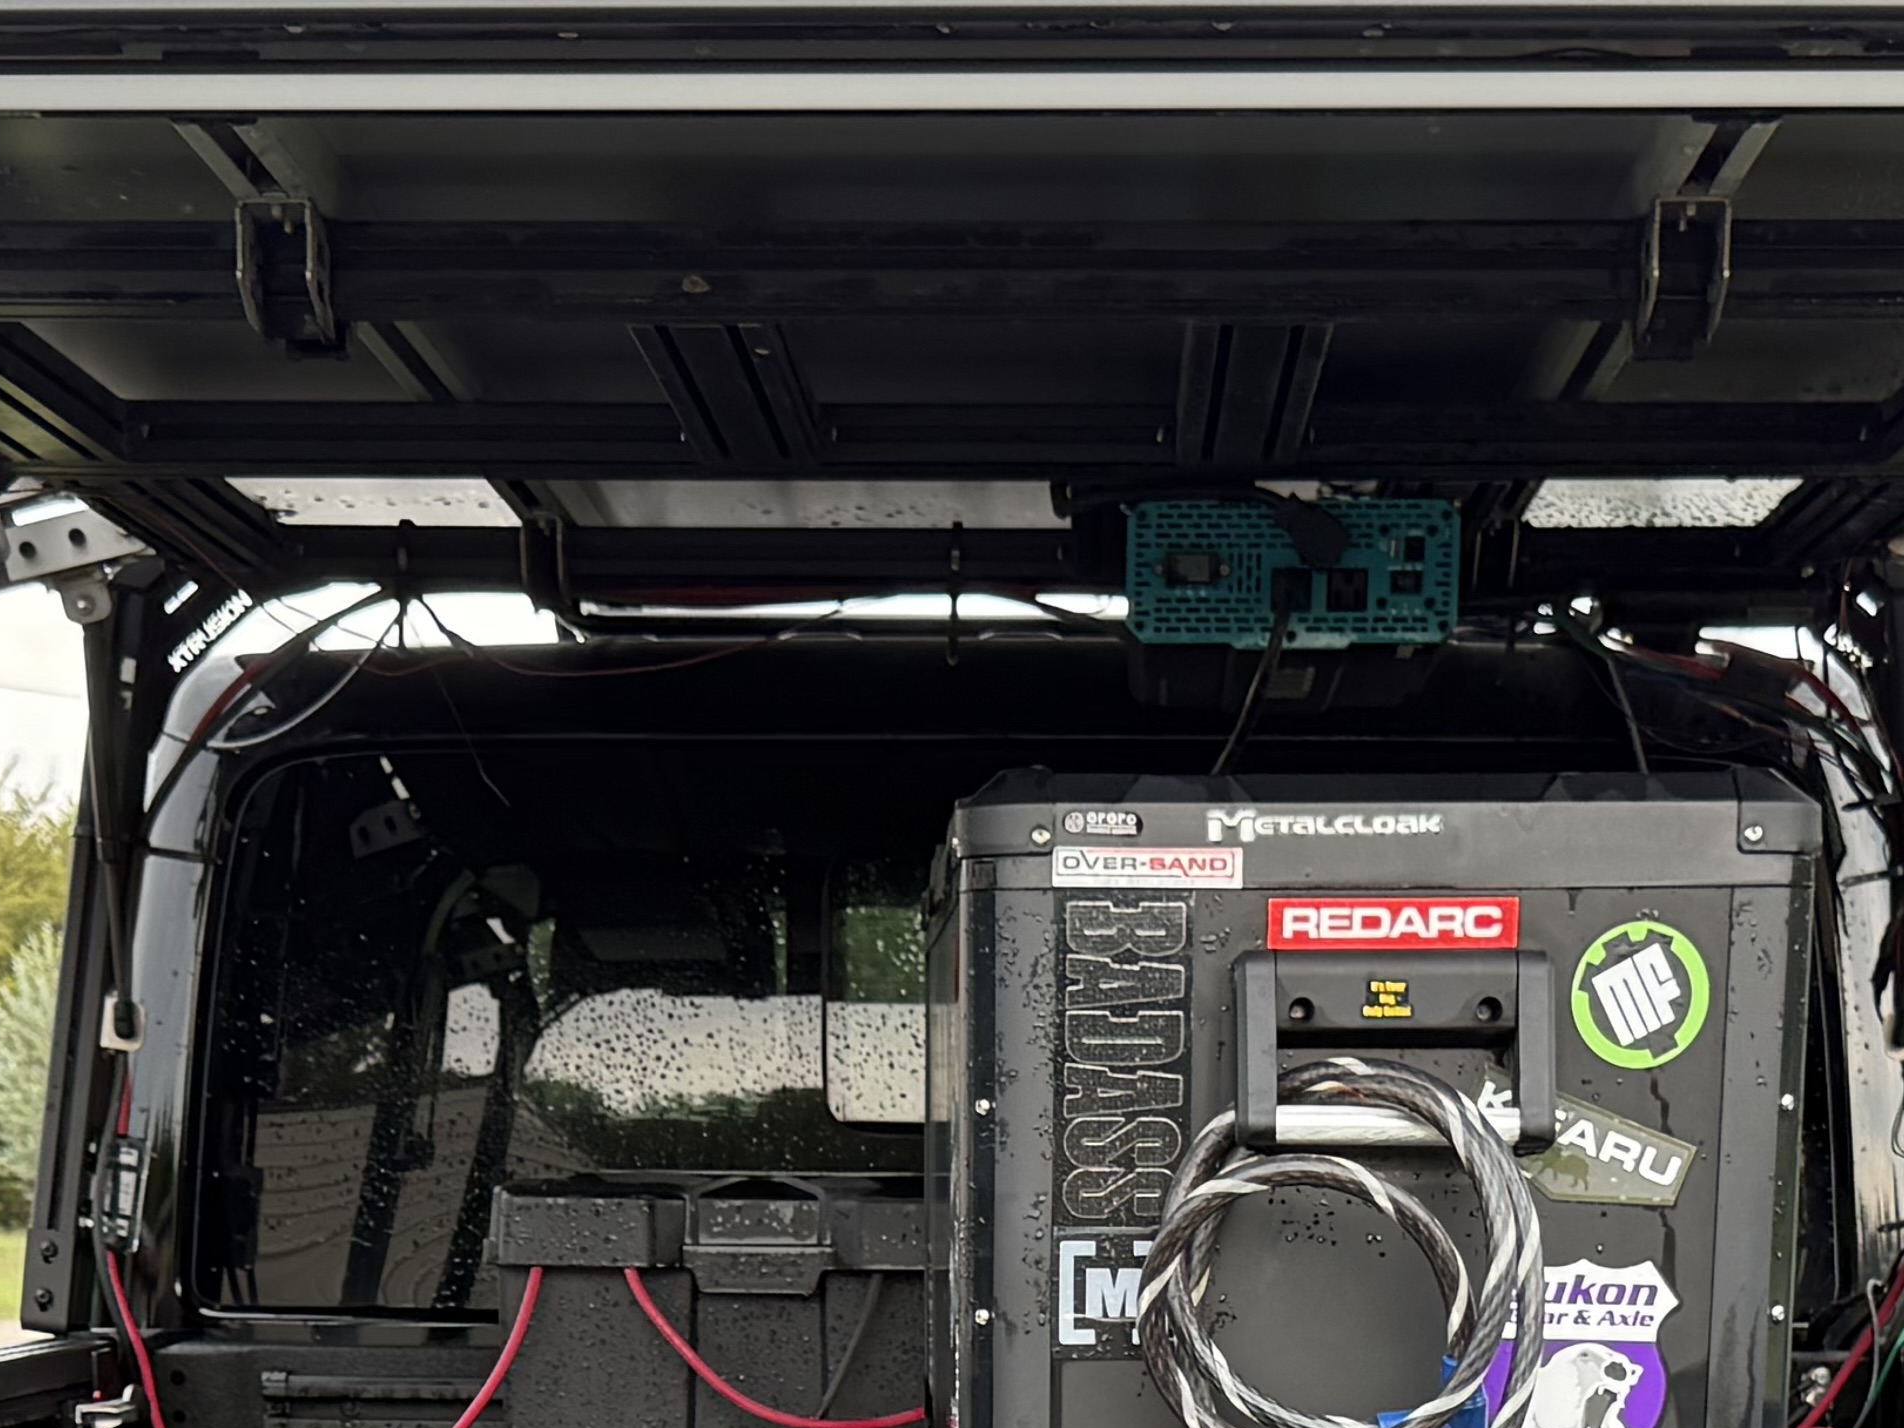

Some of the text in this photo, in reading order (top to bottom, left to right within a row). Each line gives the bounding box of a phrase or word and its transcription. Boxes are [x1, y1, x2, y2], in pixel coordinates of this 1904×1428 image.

[1062, 850, 1228, 875] OVER-SAND
[1282, 906, 1503, 940] REDARC
[1592, 942, 1681, 1047] MF
[1063, 902, 1187, 1219] BADASS
[1477, 1080, 1682, 1187] KARU
[1543, 1274, 1658, 1307] ukon
[1573, 1309, 1591, 1326] &
[1597, 1310, 1655, 1327] Axle
